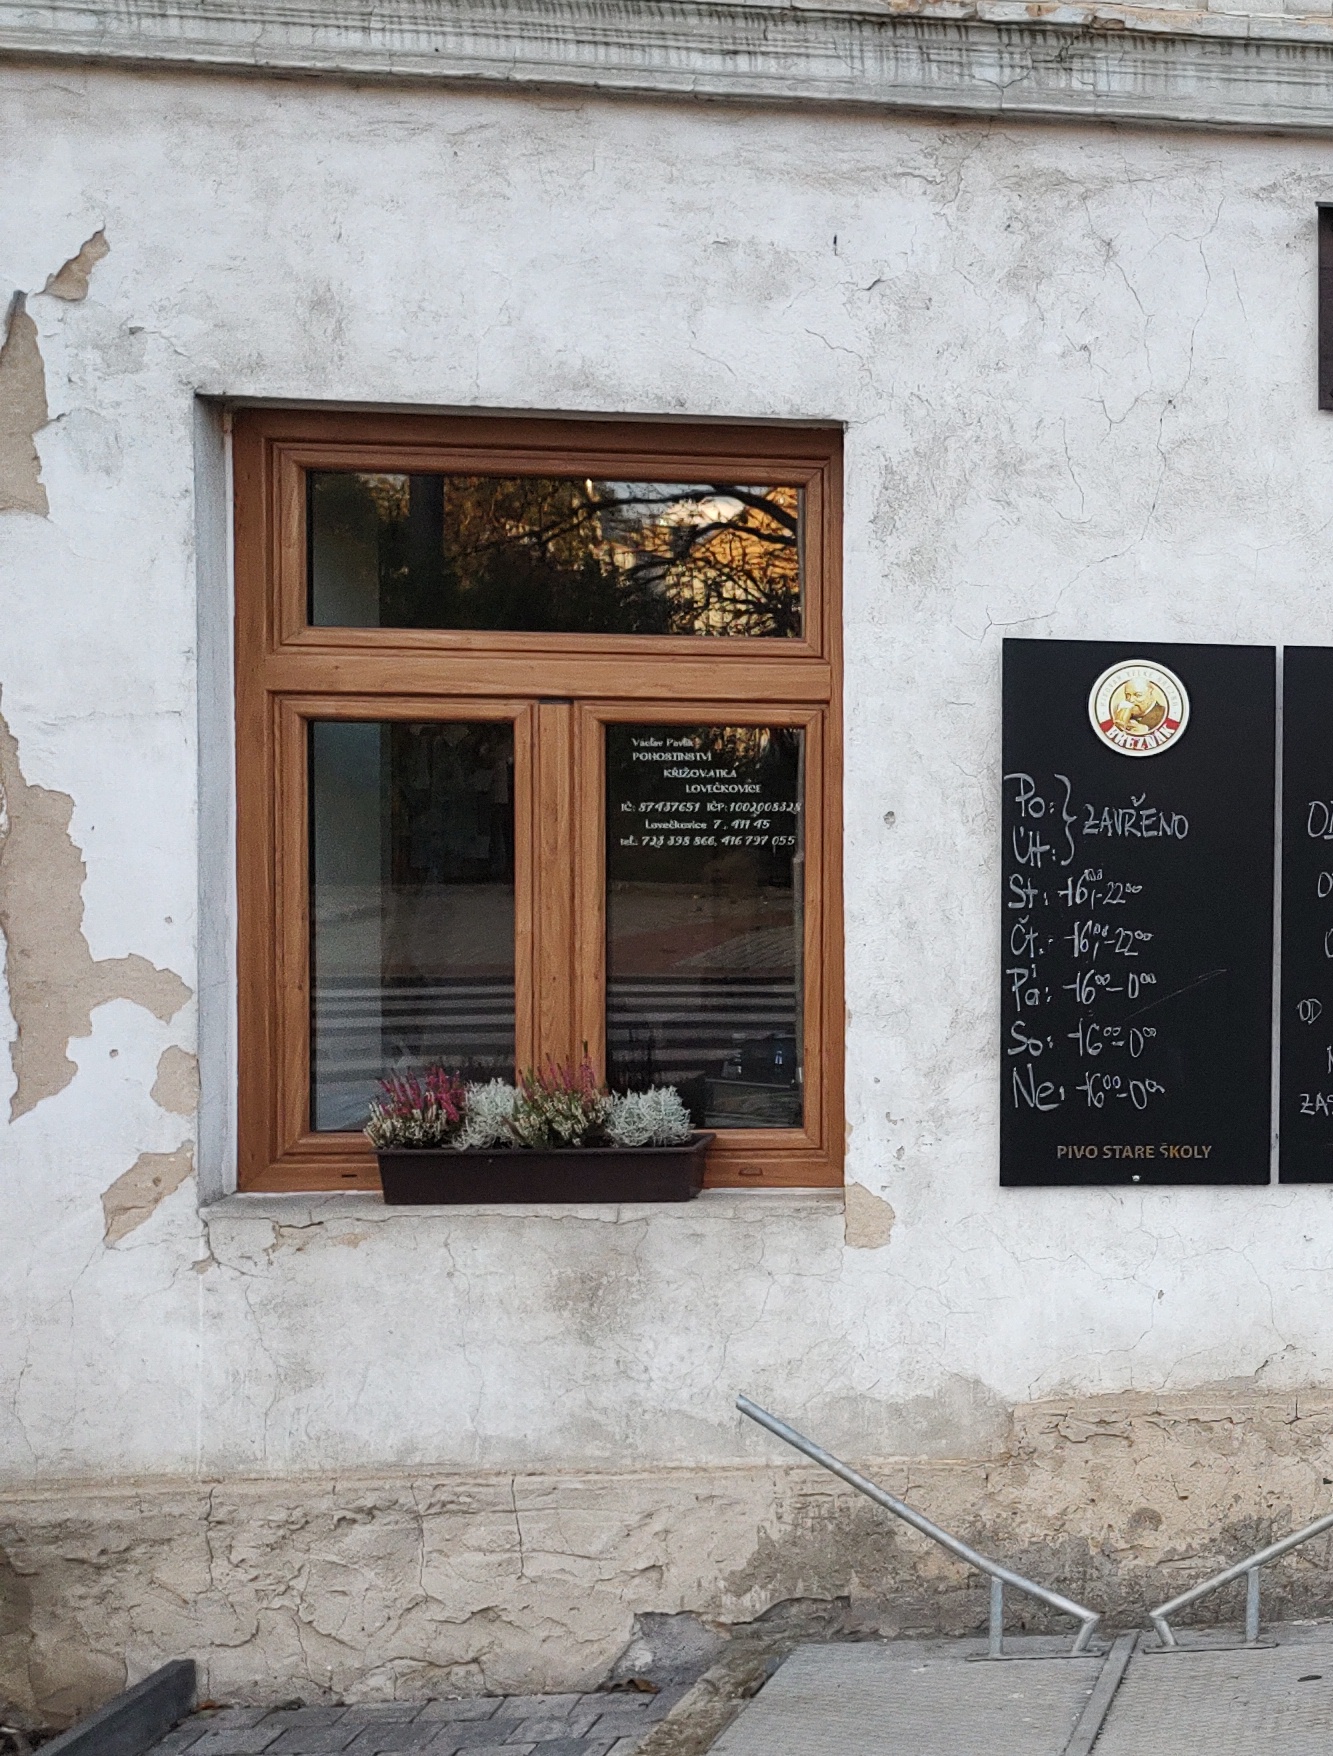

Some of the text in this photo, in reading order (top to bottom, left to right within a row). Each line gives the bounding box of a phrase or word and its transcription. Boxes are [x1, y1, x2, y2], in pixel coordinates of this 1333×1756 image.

[686, 783, 761, 793] LOVEČKOVICE
[1083, 793, 1188, 839] ZAVŘENO
[1296, 998, 1322, 1025] OD
[1057, 1145, 1098, 1159] PIVO
[1159, 1142, 1212, 1159] ŠKOLY
